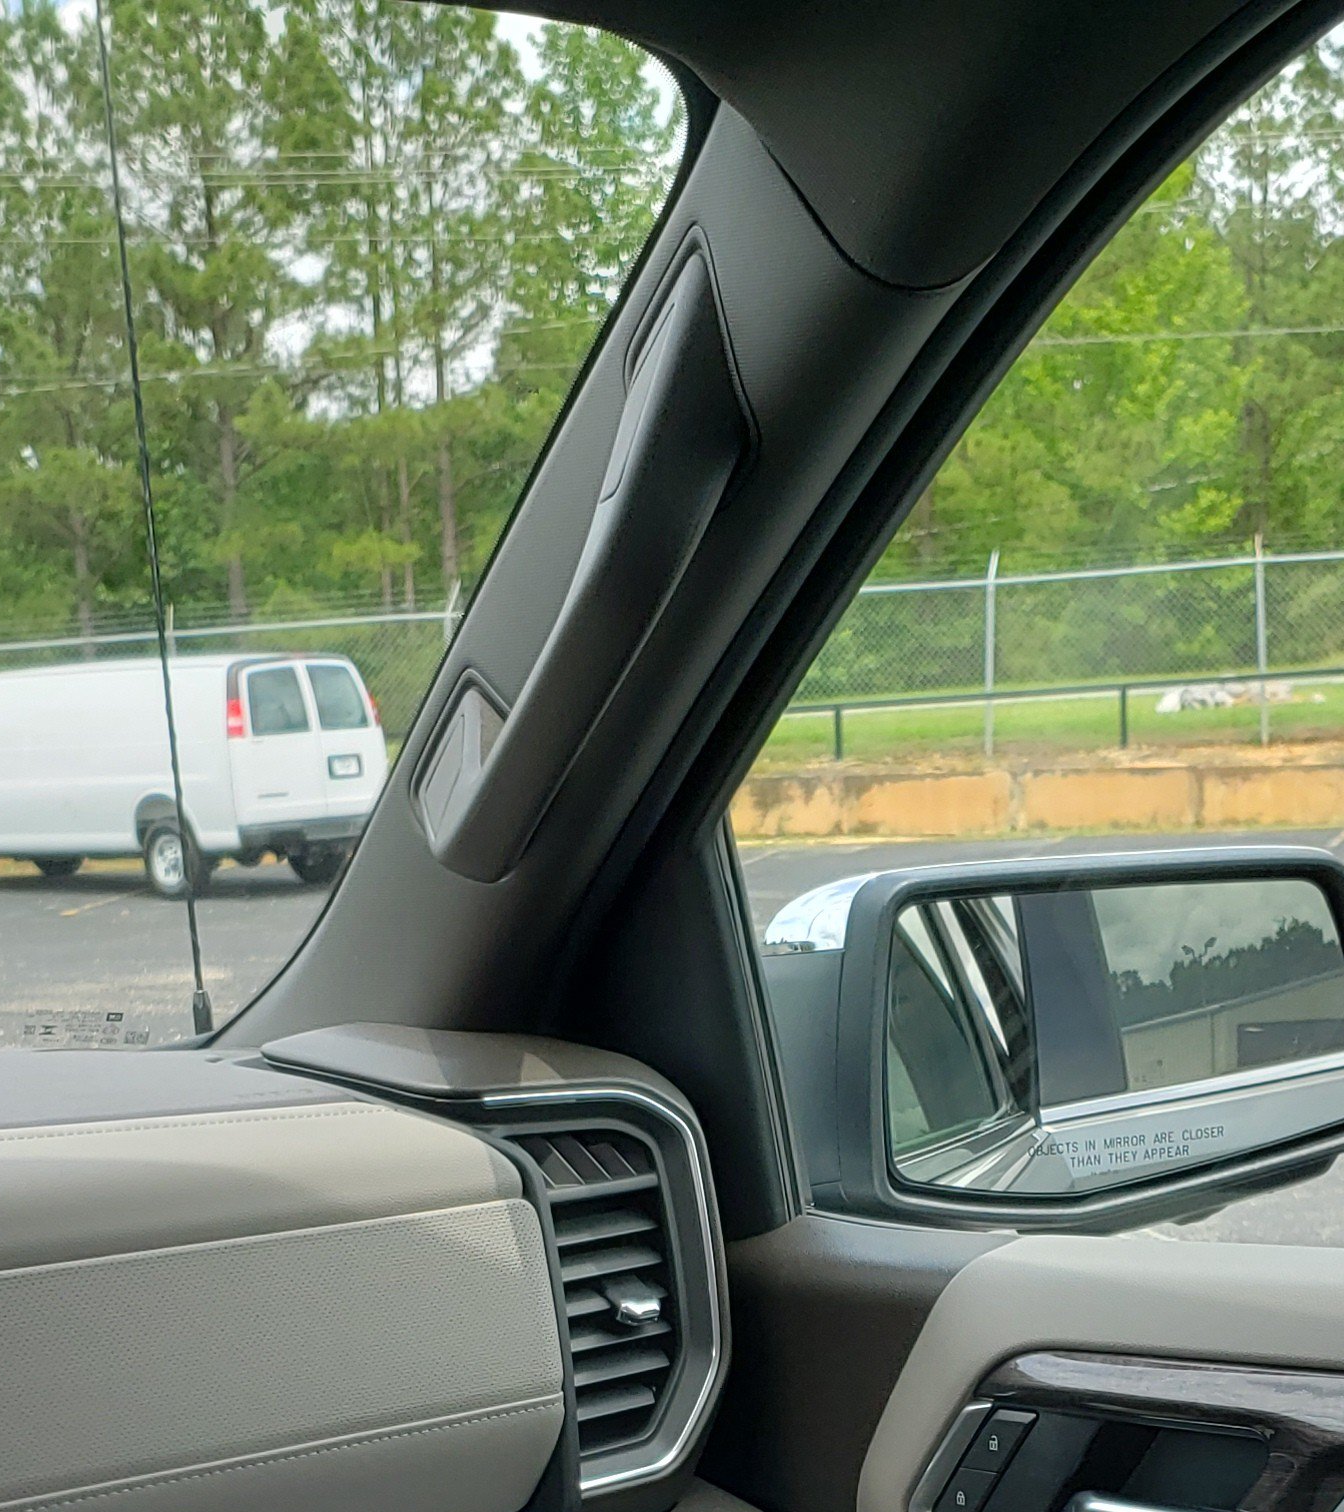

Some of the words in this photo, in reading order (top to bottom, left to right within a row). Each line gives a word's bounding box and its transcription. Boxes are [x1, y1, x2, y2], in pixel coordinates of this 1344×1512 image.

[1027, 1141, 1078, 1157] OBJECTS
[1085, 1139, 1096, 1151] IN
[1104, 1134, 1146, 1150] MIRROR
[1153, 1131, 1175, 1144] ARE
[1182, 1125, 1225, 1141] CLOSER
[1070, 1154, 1102, 1168] THAN
[1108, 1150, 1139, 1165] THEY
[1143, 1145, 1190, 1161] APPEAR
